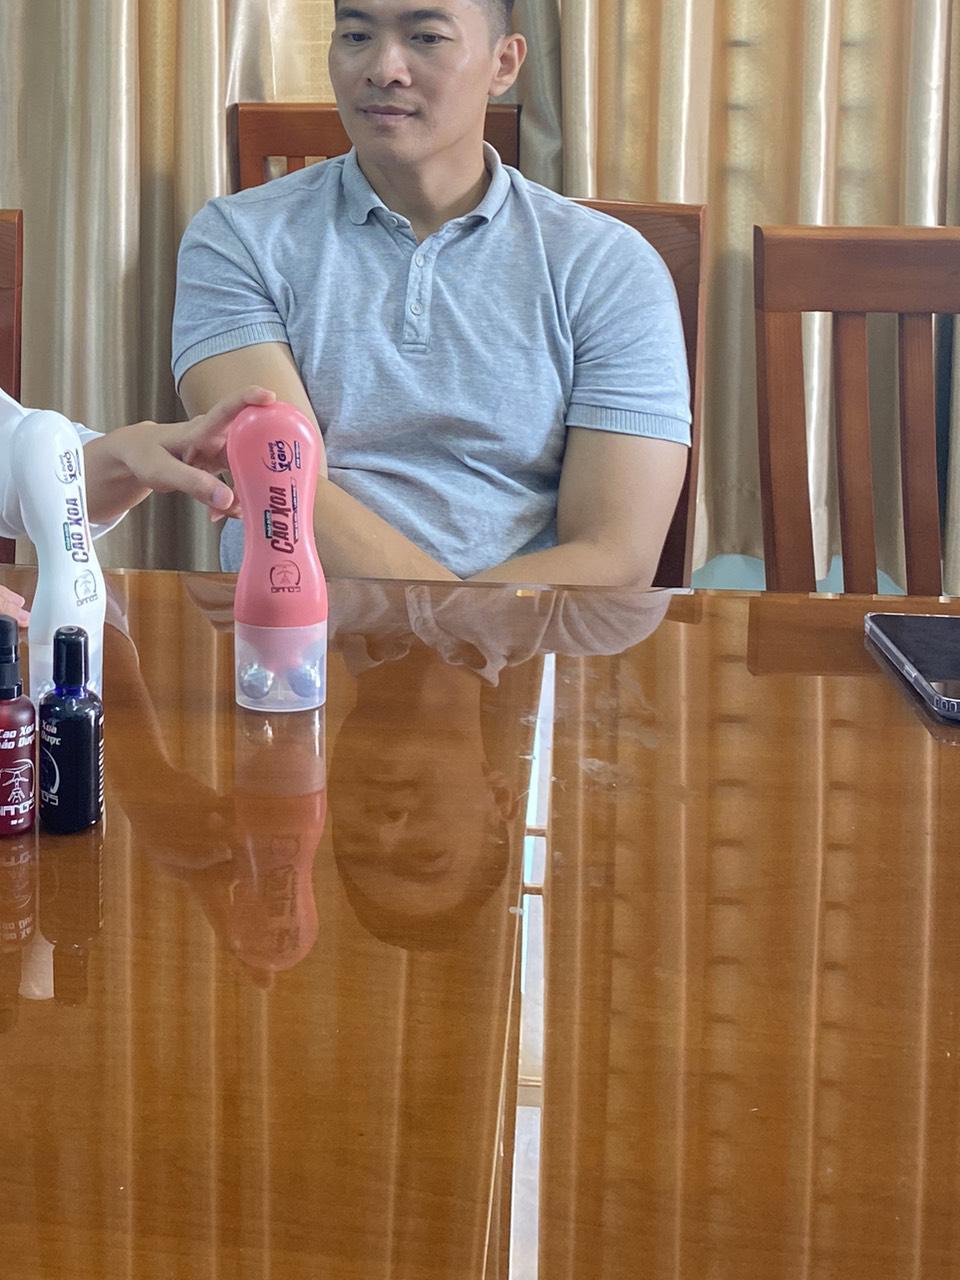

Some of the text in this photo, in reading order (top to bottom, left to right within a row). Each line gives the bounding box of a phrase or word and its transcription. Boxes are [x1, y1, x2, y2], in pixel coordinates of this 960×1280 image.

[65, 497, 89, 563] CAO XOA
[269, 486, 294, 554] CAO XOA
